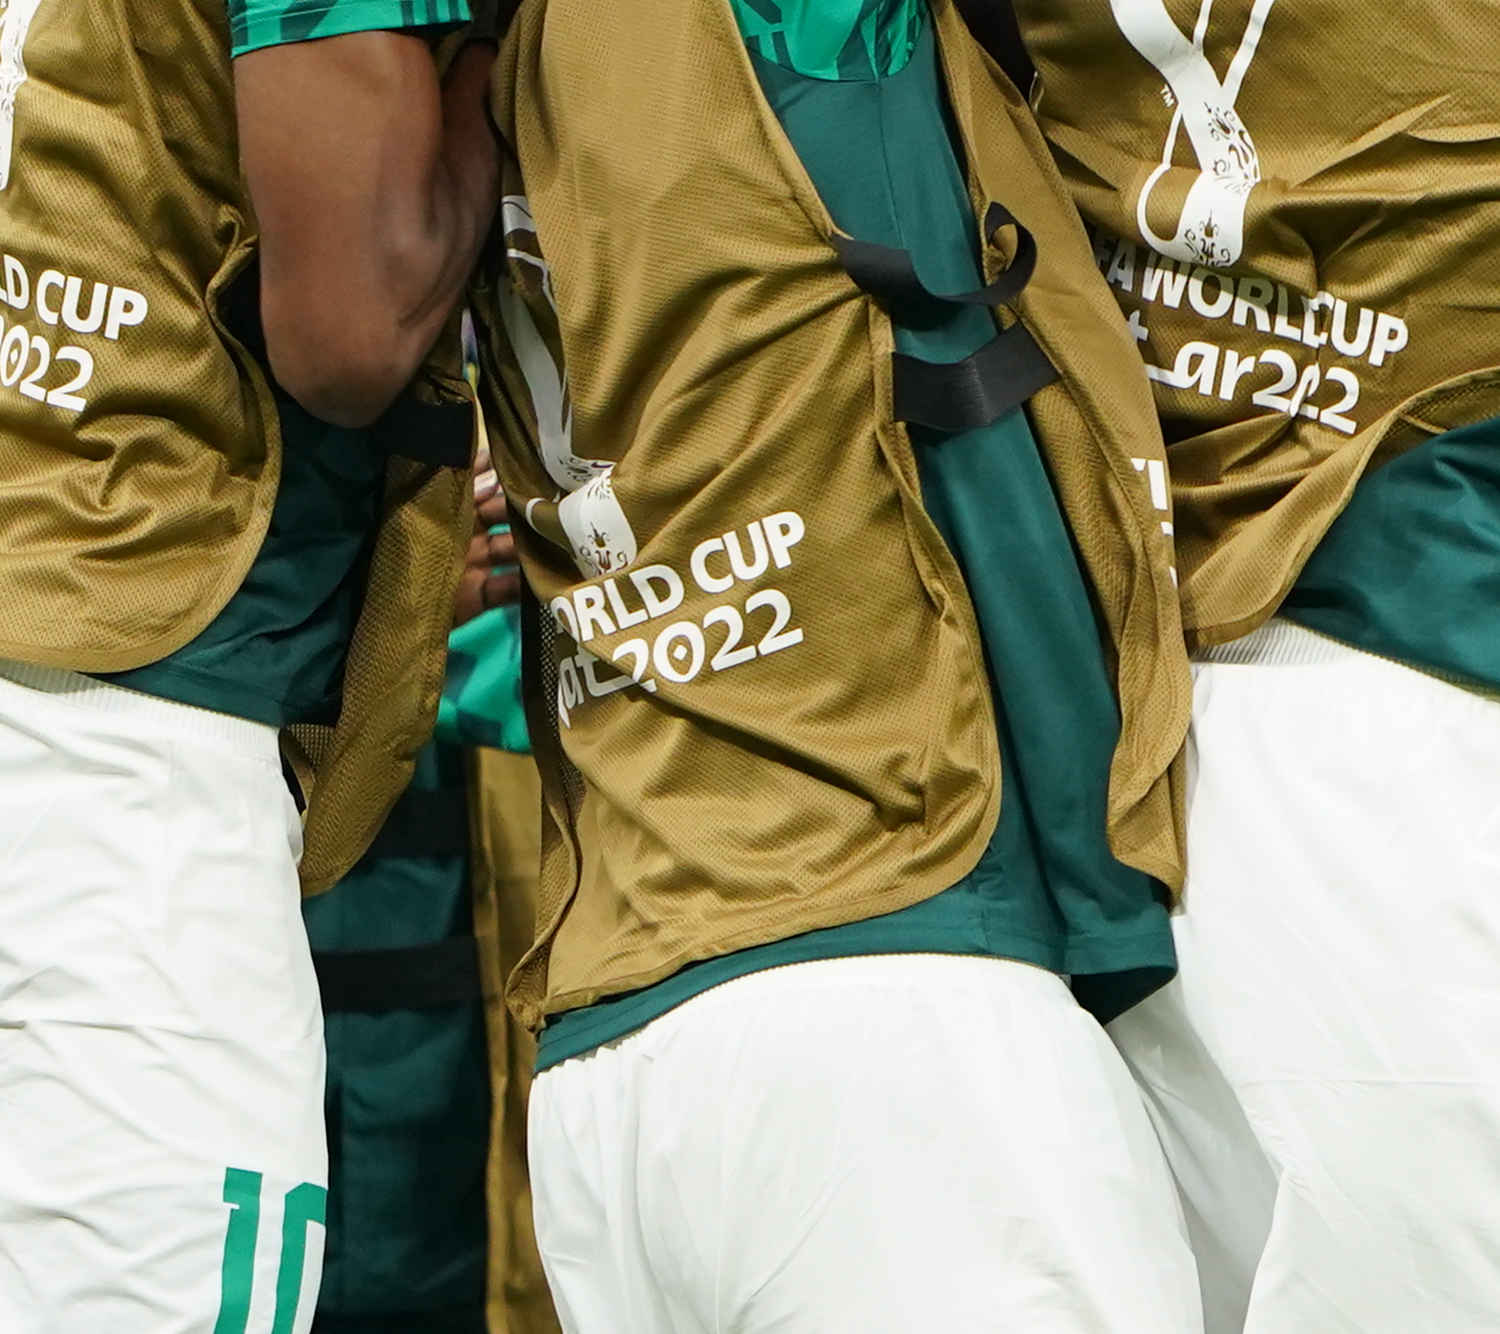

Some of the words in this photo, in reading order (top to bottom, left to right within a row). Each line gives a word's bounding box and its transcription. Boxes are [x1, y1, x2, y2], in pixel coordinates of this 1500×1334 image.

[36, 269, 148, 340] CUP
[551, 565, 686, 644] ORLD
[690, 511, 806, 593] CUP
